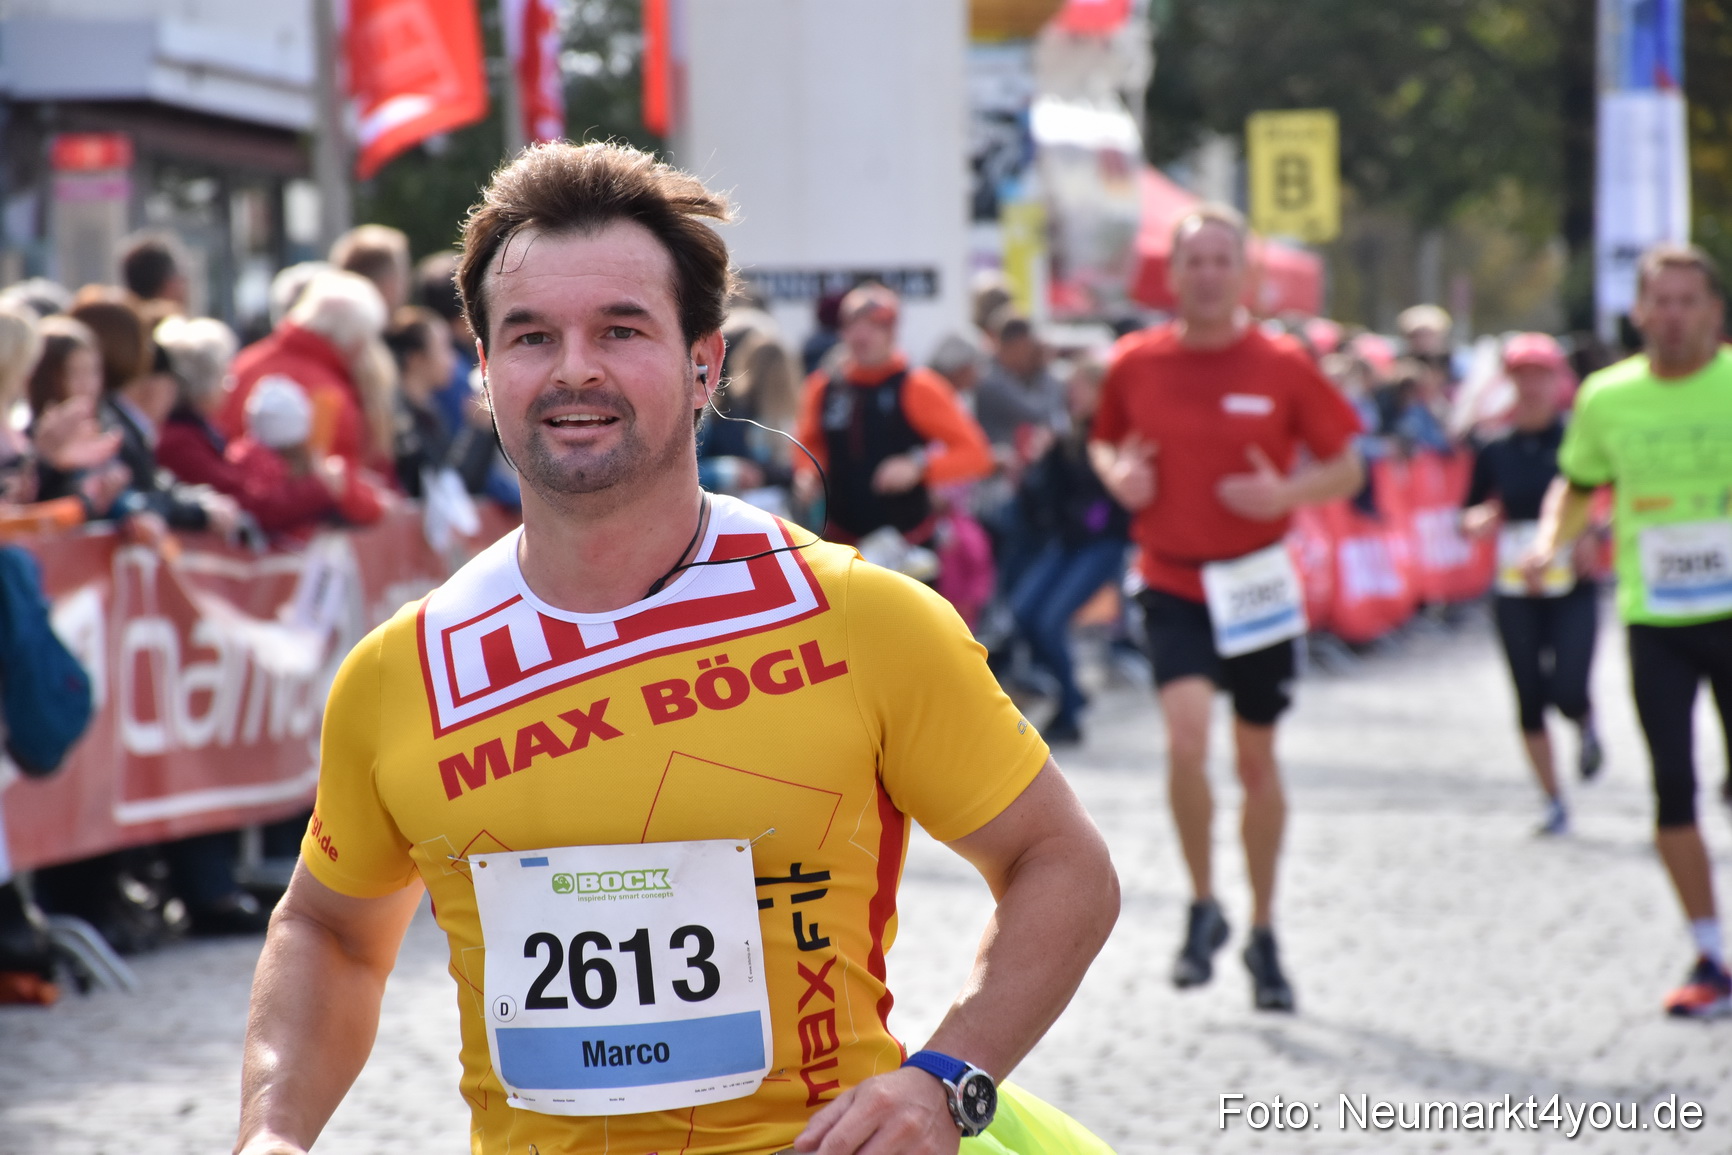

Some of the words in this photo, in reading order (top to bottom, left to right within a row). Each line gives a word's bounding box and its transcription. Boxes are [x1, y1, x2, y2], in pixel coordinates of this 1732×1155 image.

[438, 696, 624, 801] MAX
[640, 639, 849, 726] BÖGL
[576, 869, 672, 894] BOCK
[577, 894, 606, 903] inspired
[608, 892, 617, 902] by
[641, 891, 674, 900] concepts
[523, 924, 721, 1011] 2613
[500, 1002, 509, 1016] D
[582, 1041, 671, 1068] Marco
